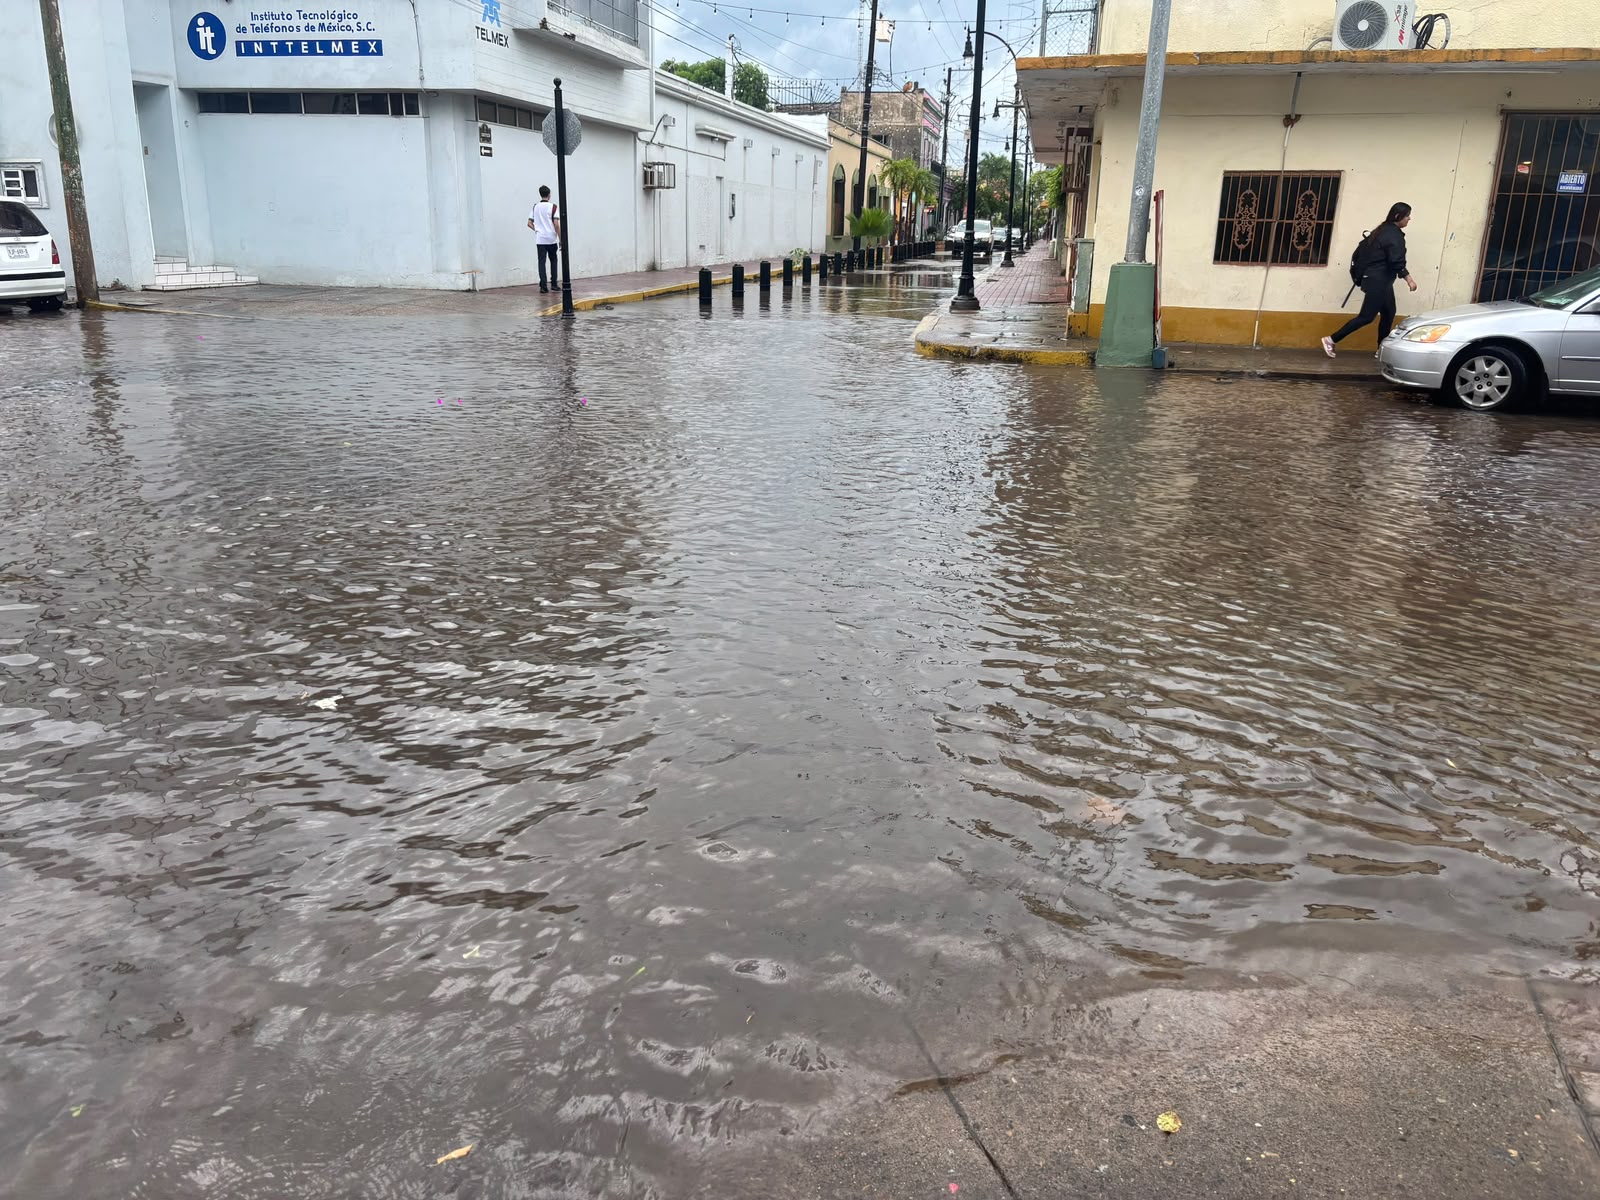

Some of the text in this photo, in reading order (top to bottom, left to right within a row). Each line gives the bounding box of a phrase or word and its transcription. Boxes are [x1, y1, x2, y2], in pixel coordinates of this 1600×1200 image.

[250, 10, 359, 23] Instituto Tecnológico
[235, 22, 376, 34] de Teléfonos de México, S.C.
[475, 25, 509, 49] TELMEX
[241, 41, 378, 54] INTTELMEX
[1560, 174, 1586, 184] ABIERTO
